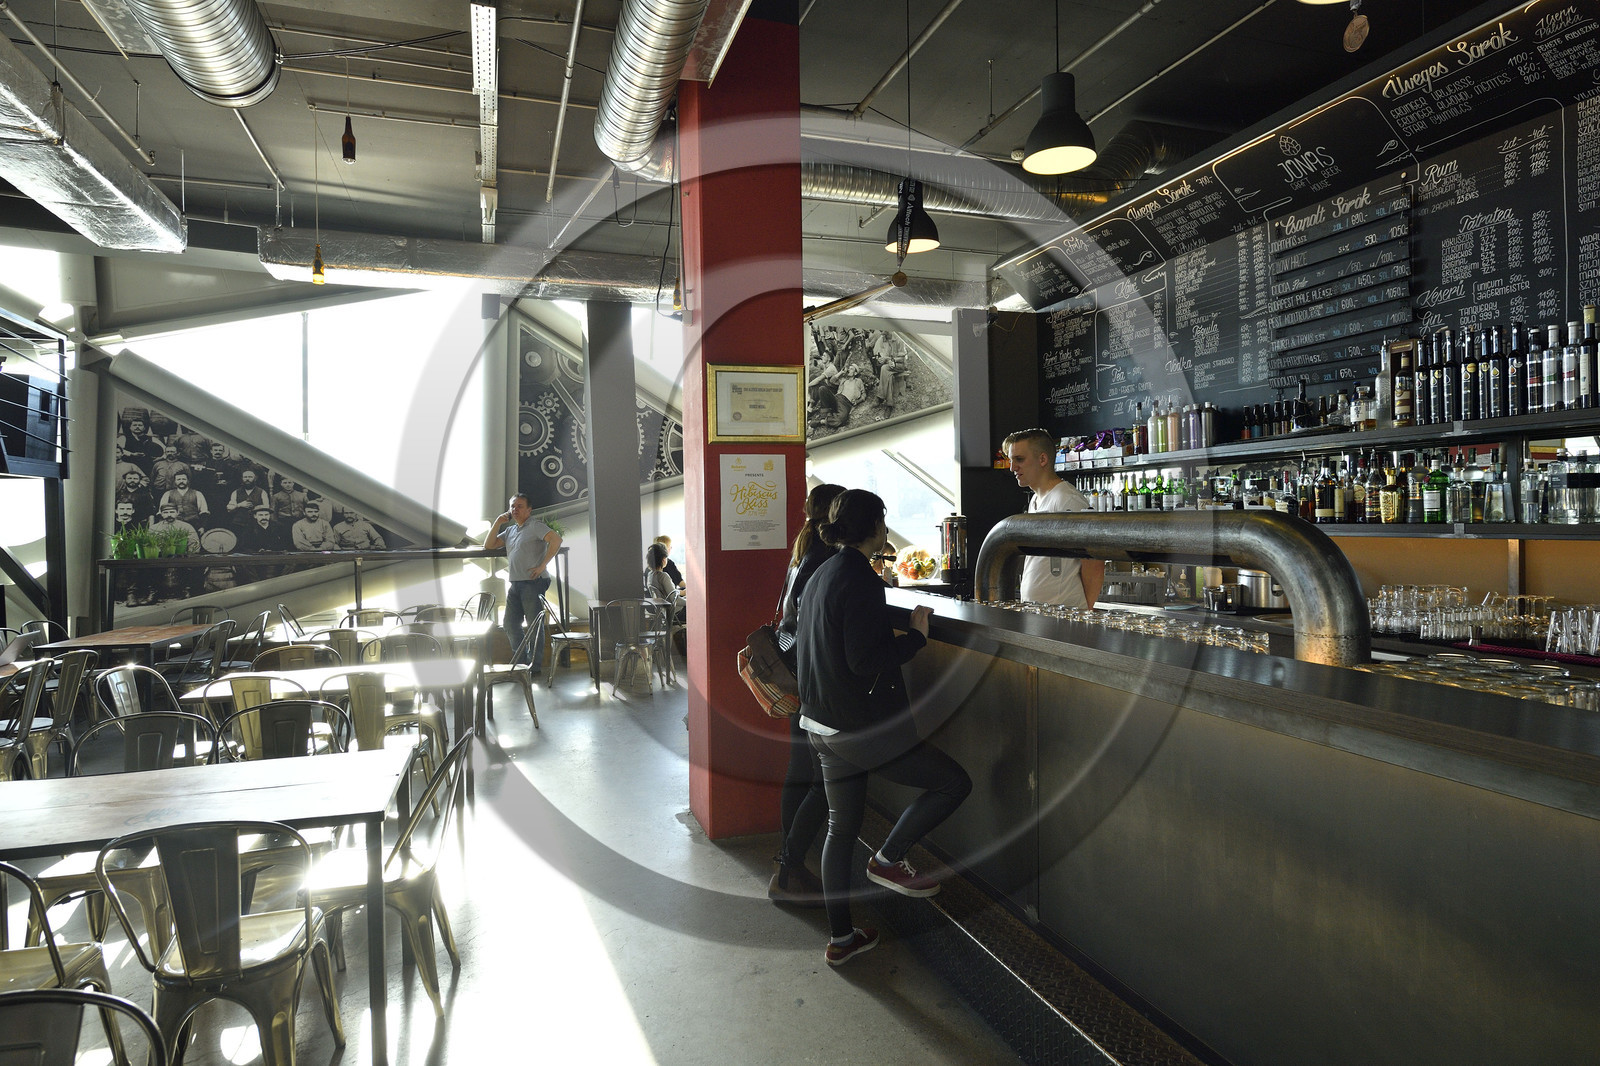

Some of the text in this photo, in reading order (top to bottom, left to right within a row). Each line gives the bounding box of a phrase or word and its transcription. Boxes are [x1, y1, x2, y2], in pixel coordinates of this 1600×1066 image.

[1382, 22, 1519, 99] Üveges Sörök
[1390, 96, 1429, 120] ERDINGER
[1431, 76, 1475, 102] URWEISSE
[1397, 106, 1436, 129] ERDINGER
[1474, 72, 1512, 96] MENTES
[1421, 160, 1459, 186] Rum
[1126, 200, 1161, 220] Üveges
[1156, 179, 1195, 204] Sörök
[1332, 187, 1371, 218] Sörök
[1165, 356, 1193, 373] Vodka
[730, 481, 778, 502] Hibiscus
[736, 497, 769, 515] Kiss
